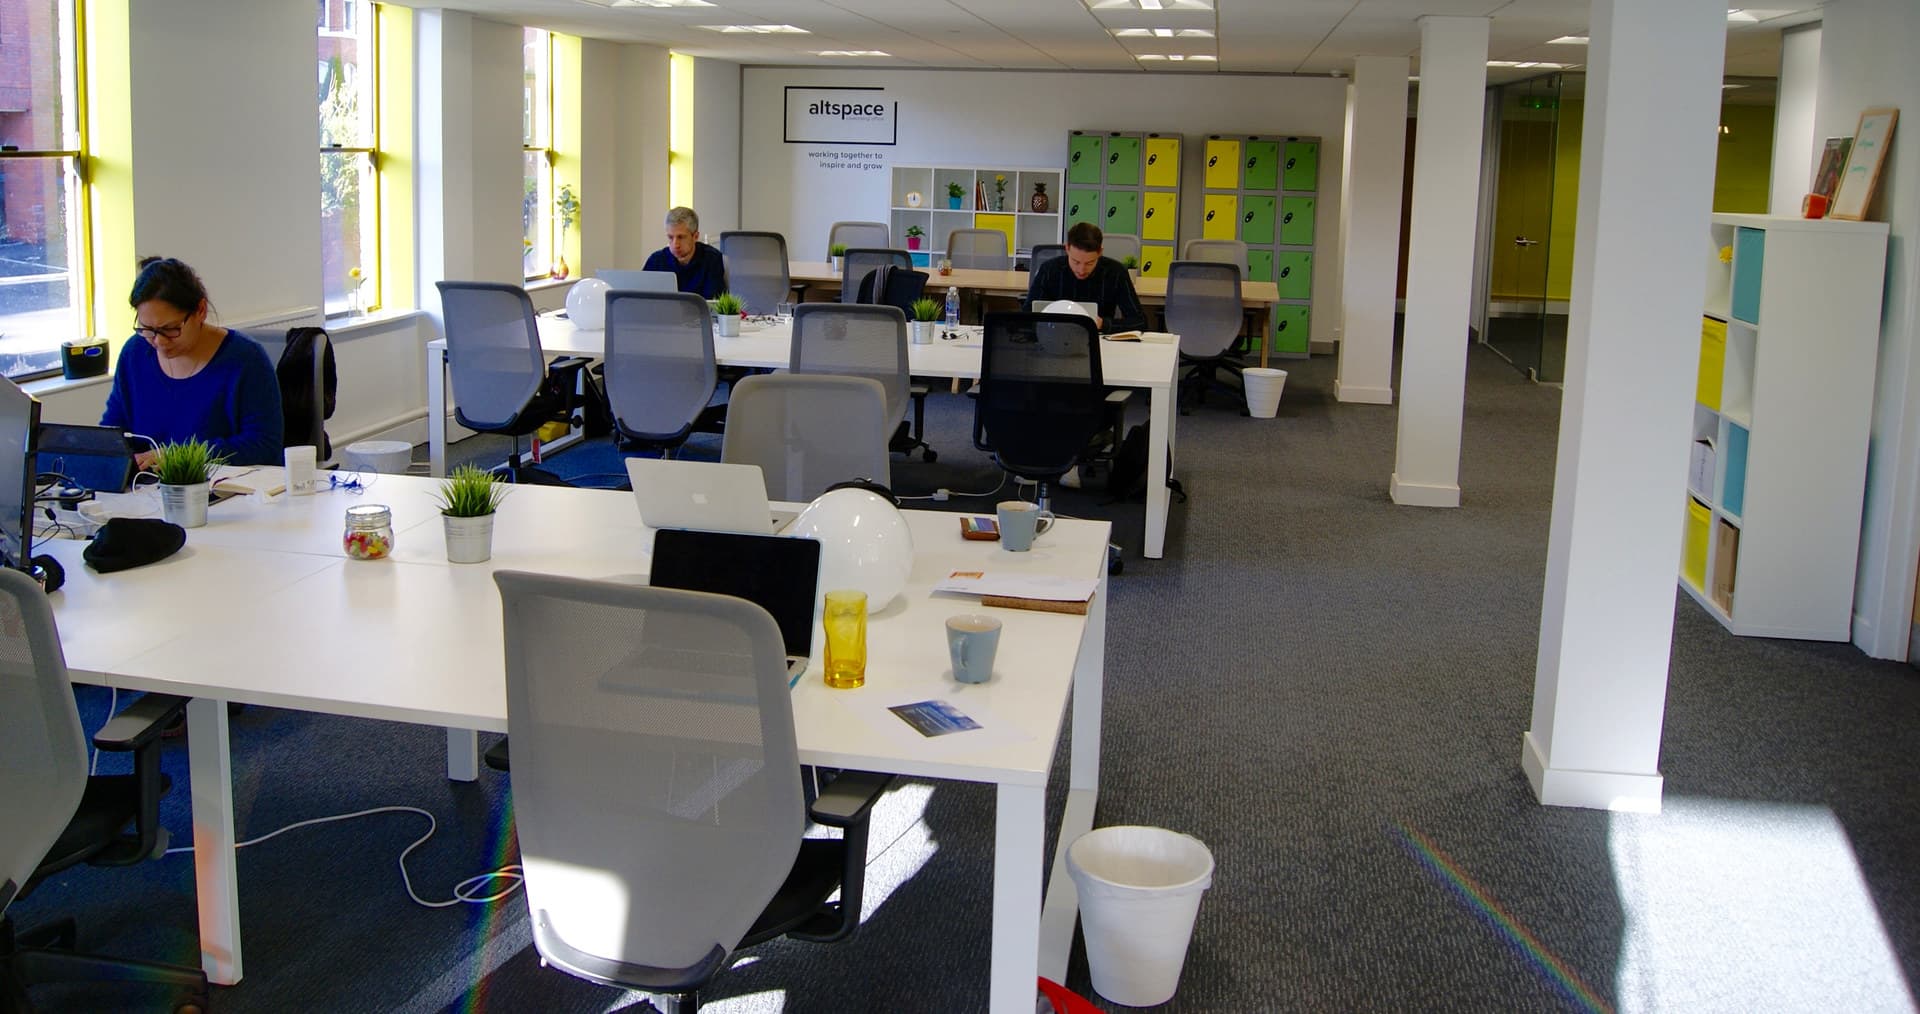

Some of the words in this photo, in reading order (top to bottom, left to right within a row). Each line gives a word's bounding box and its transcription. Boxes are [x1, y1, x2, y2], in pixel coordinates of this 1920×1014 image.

[809, 100, 884, 120] altspace
[808, 151, 839, 159] working
[841, 152, 872, 160] together
[820, 162, 845, 170] inspire
[847, 161, 861, 169] and
[863, 163, 883, 171] grow
